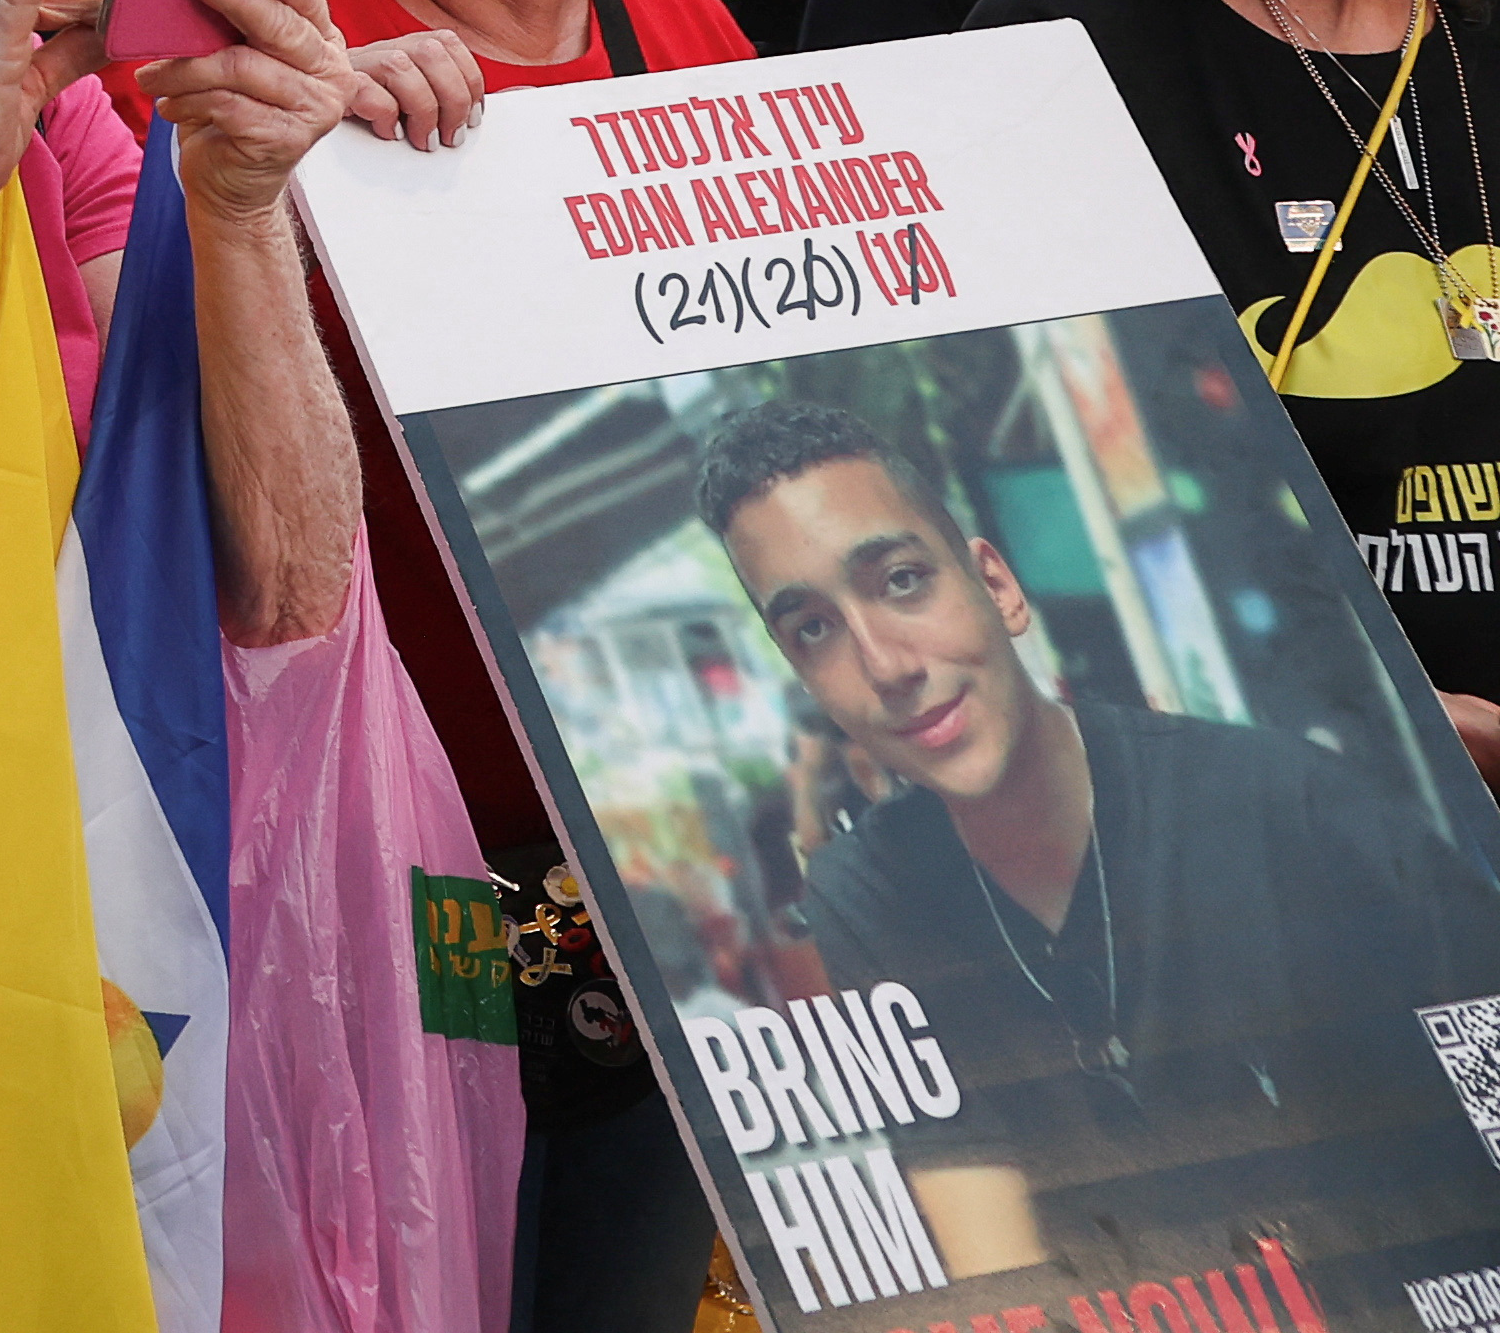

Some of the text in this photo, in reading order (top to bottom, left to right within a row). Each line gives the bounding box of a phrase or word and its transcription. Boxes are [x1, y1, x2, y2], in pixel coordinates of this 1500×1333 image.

[570, 82, 865, 179] עידן אלכסנדר
[563, 150, 944, 261] EDAN ALEXANDER
[679, 981, 962, 1156] BRING
[744, 1147, 949, 1315] HIM
